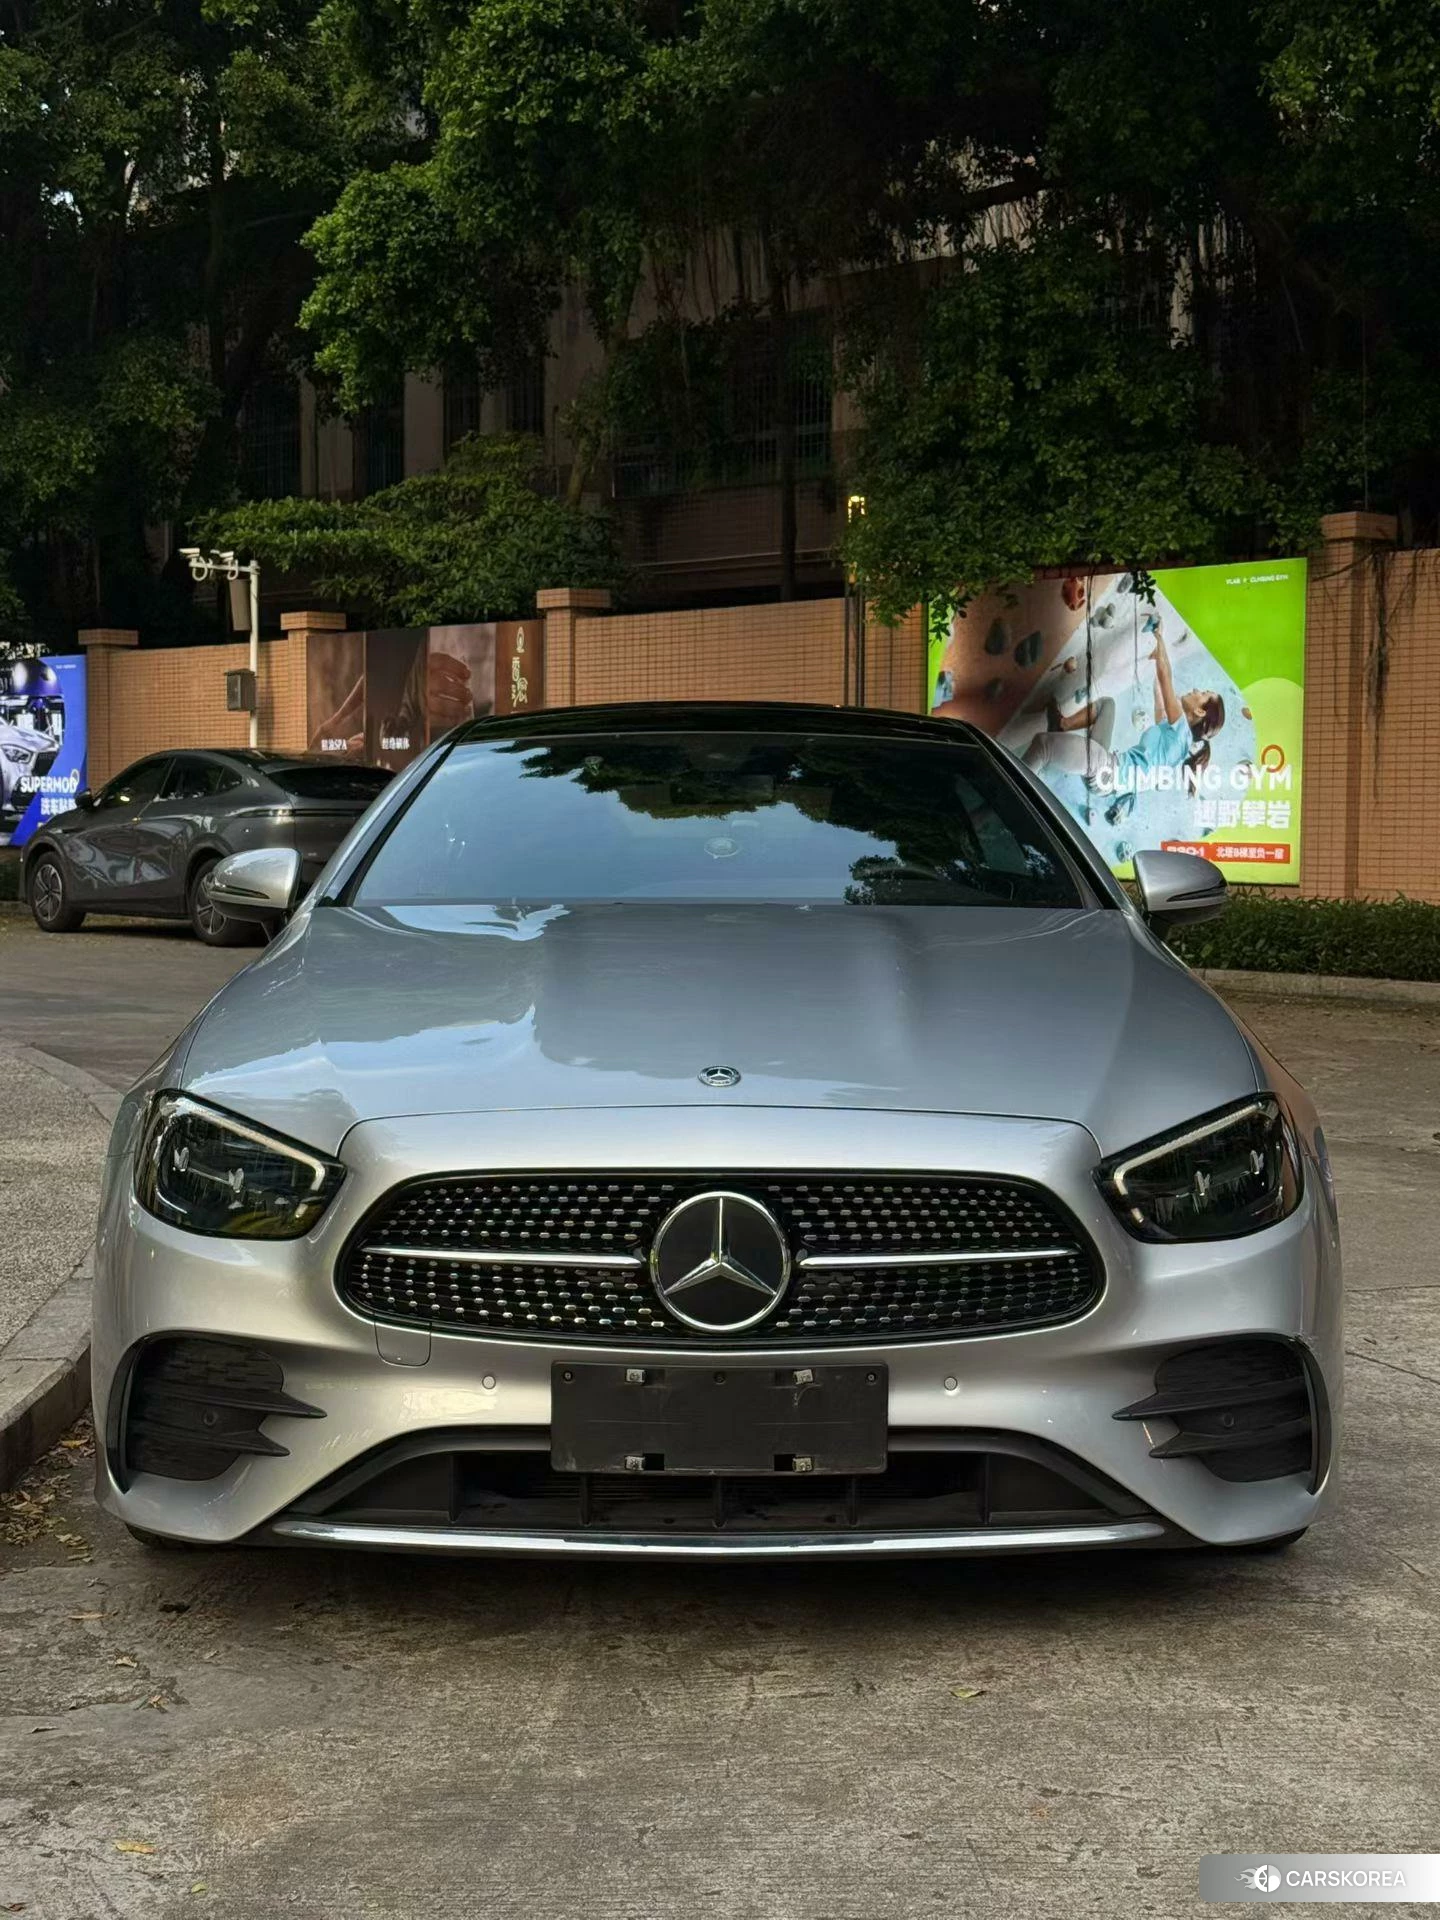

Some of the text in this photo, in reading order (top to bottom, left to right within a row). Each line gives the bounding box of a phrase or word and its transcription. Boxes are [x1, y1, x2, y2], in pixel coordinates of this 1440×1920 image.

[20, 775, 77, 794] SUPERMOD
[1096, 764, 1292, 791] CLIMBING GYM
